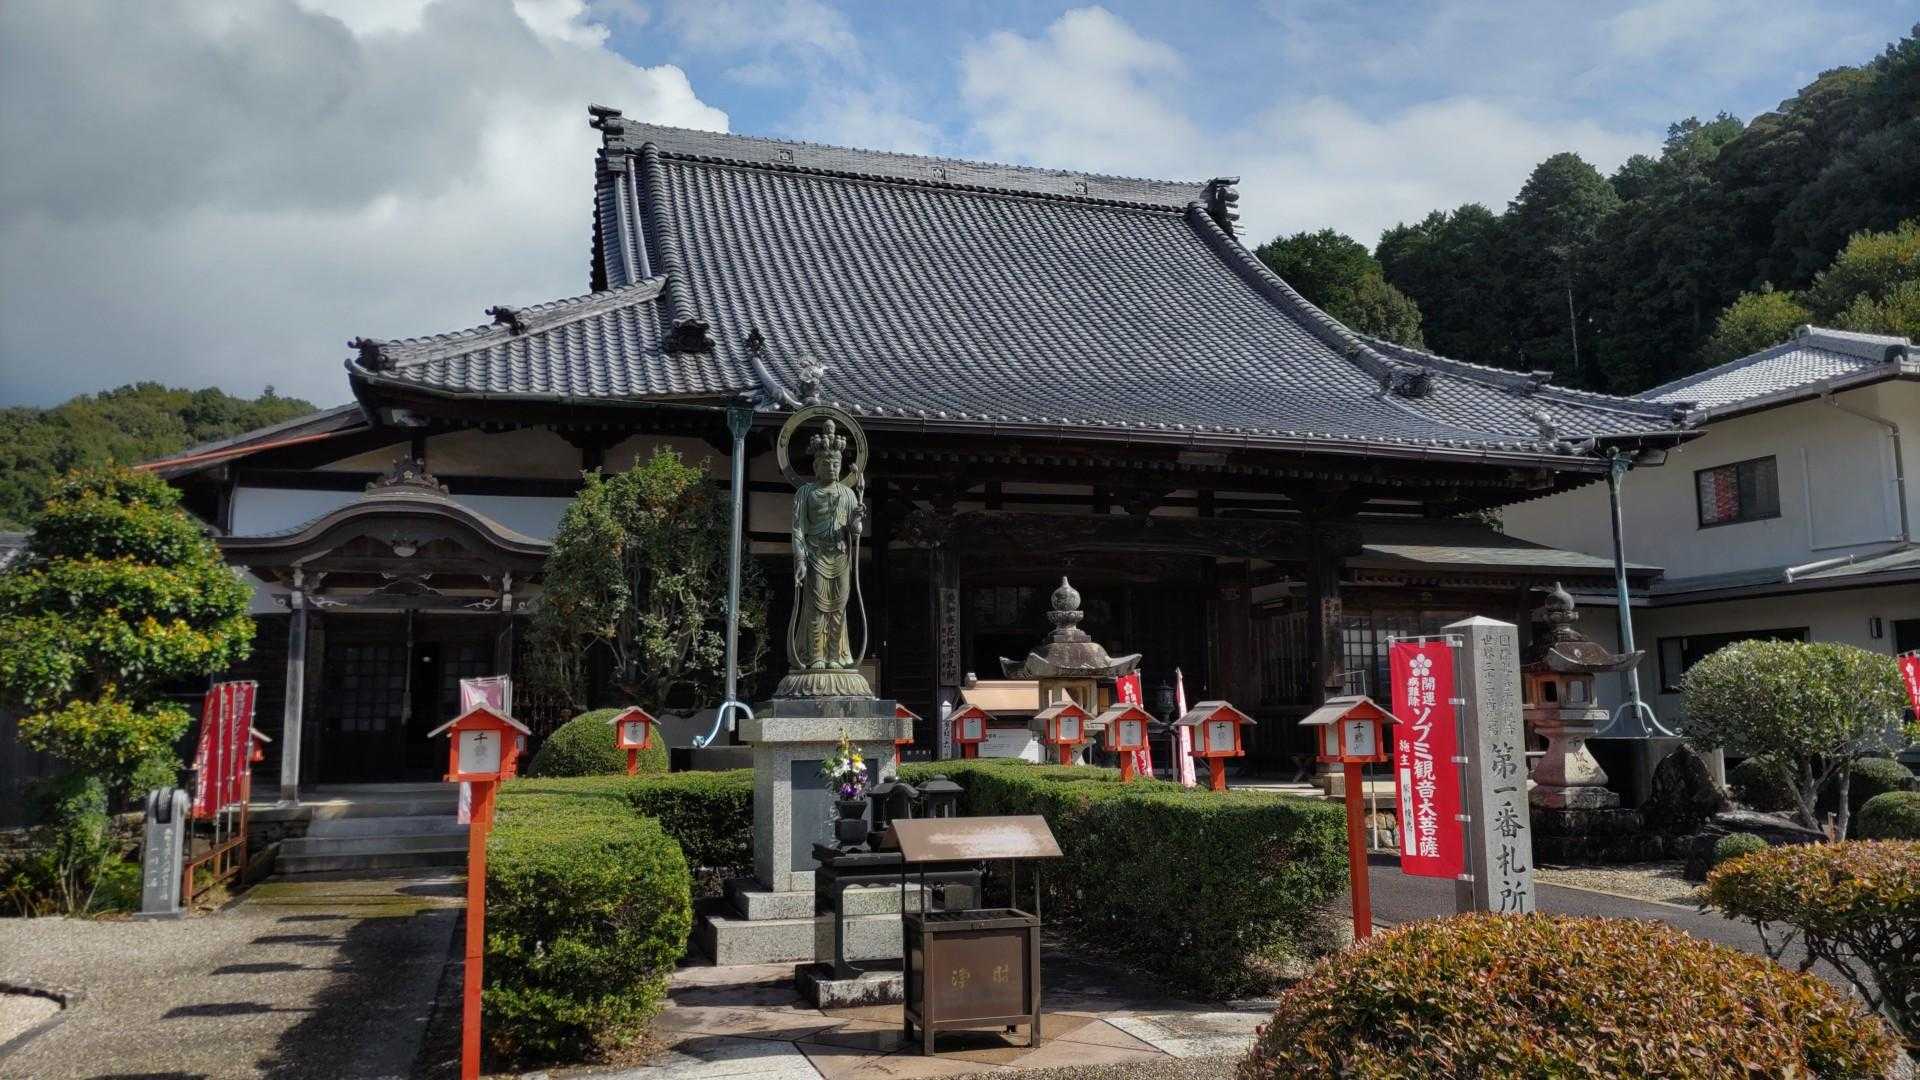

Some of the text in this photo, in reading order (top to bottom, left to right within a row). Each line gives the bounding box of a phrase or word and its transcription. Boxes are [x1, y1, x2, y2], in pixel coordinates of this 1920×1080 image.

[1421, 676, 1438, 707] 開運
[1399, 739, 1411, 766] 施主
[1491, 741, 1527, 914] 第一番札所
